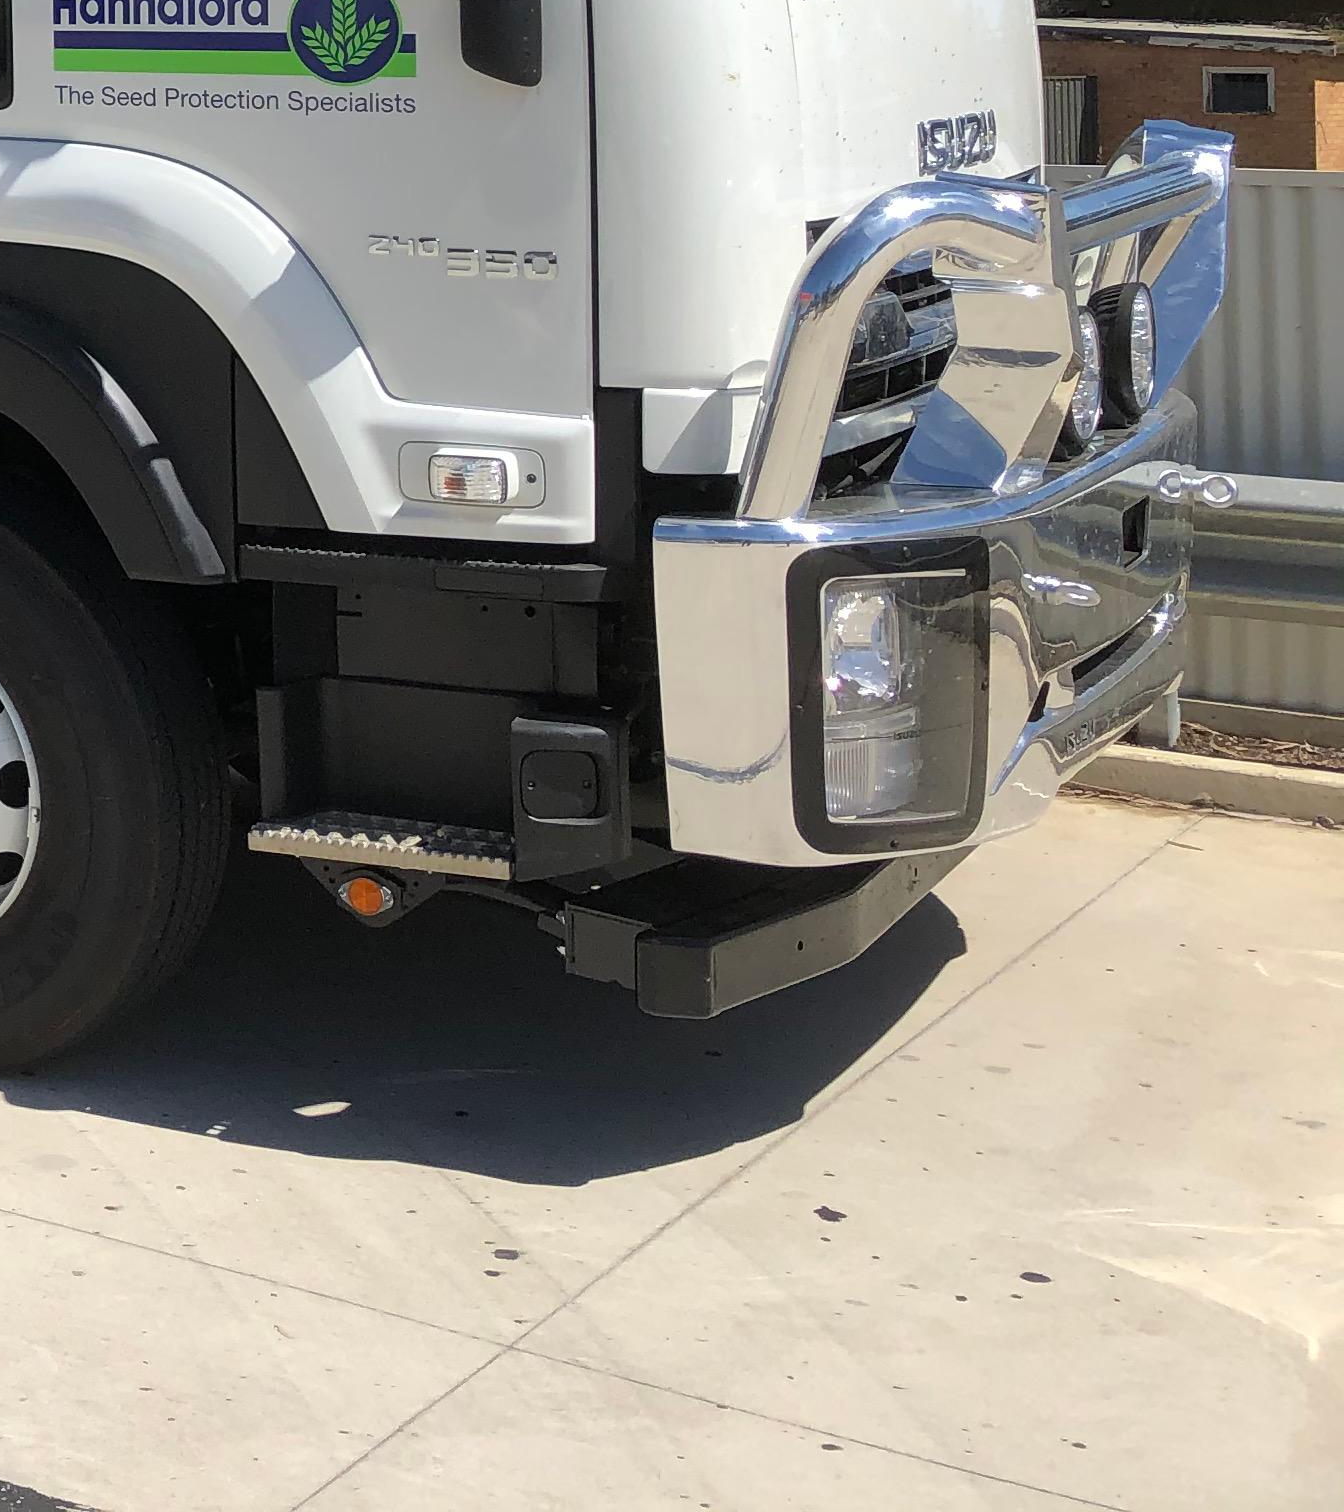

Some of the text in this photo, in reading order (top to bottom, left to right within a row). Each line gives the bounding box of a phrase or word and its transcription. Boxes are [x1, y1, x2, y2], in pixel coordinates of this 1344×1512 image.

[54, 86, 416, 116] The Seed Protection Specialists
[917, 109, 997, 177] ISUZU
[368, 235, 558, 280] 240 350
